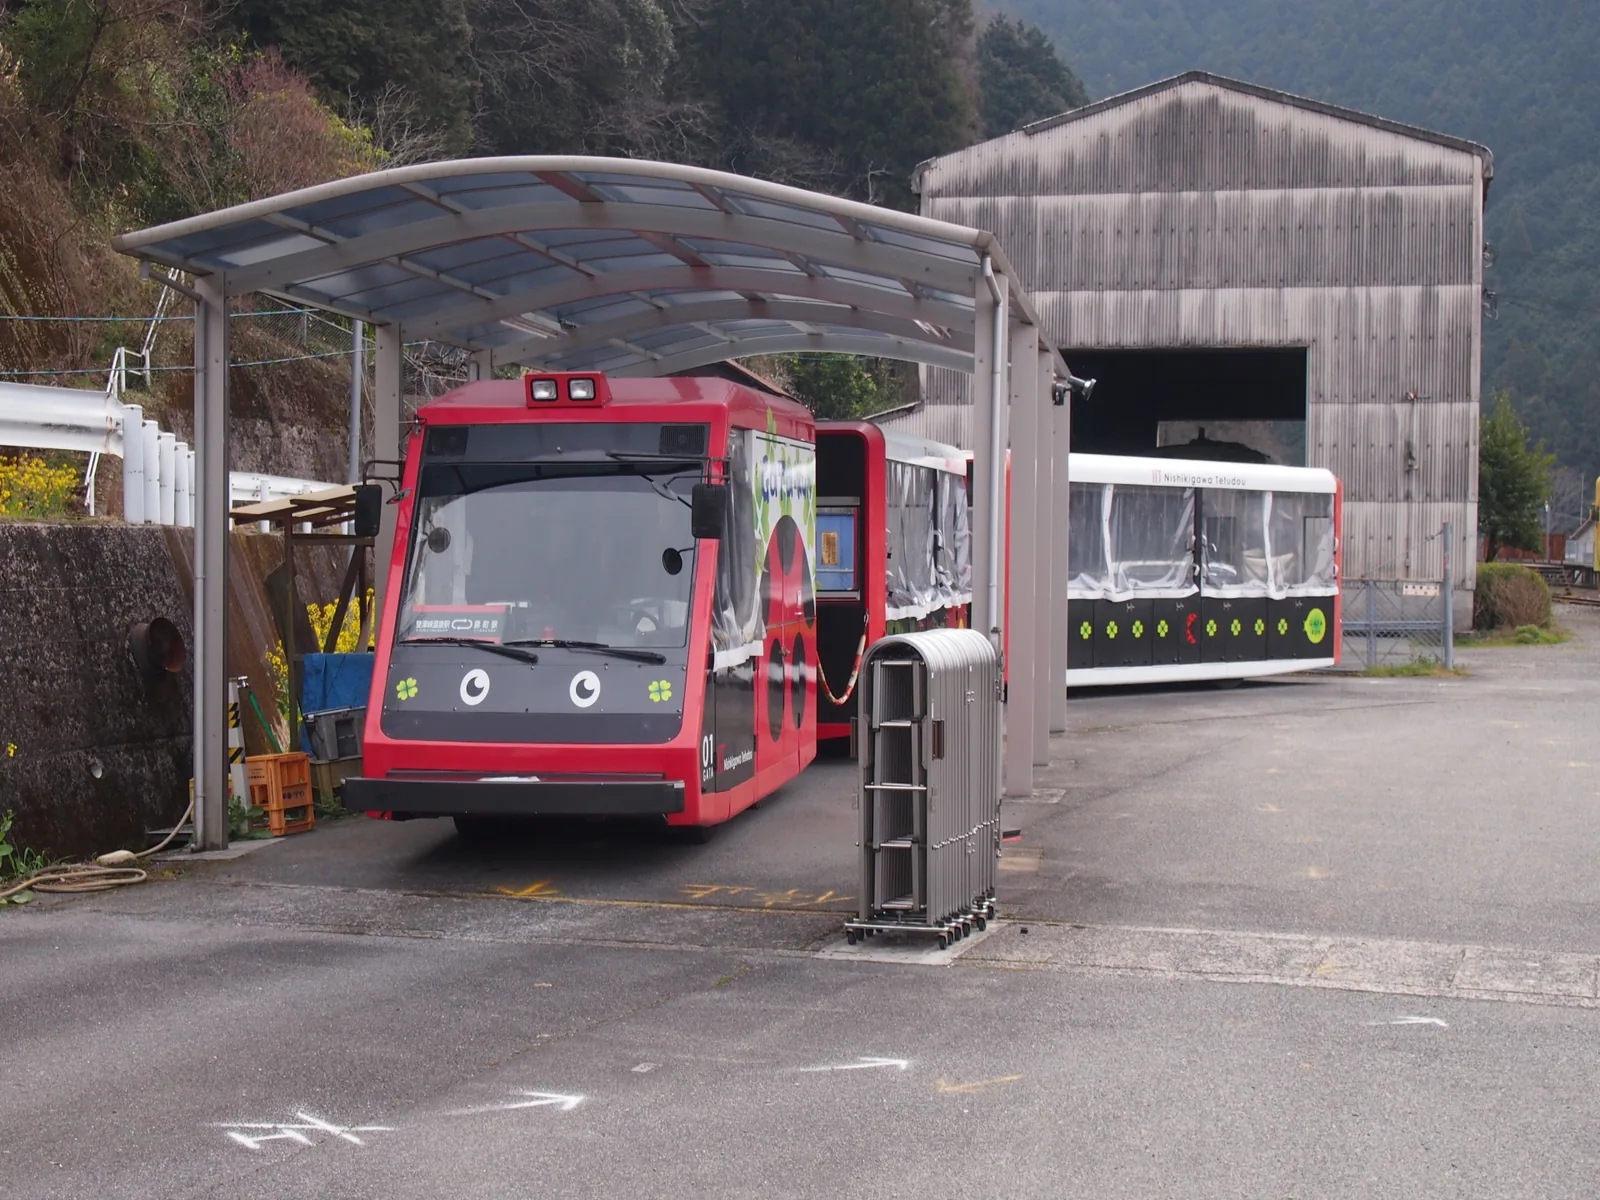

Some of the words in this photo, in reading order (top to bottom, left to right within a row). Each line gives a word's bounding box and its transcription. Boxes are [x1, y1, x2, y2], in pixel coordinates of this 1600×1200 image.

[1164, 473, 1213, 486] Nishikigawa
[1215, 476, 1246, 486] Tetudou
[702, 733, 713, 767] 01
[703, 766, 714, 782] GATA
